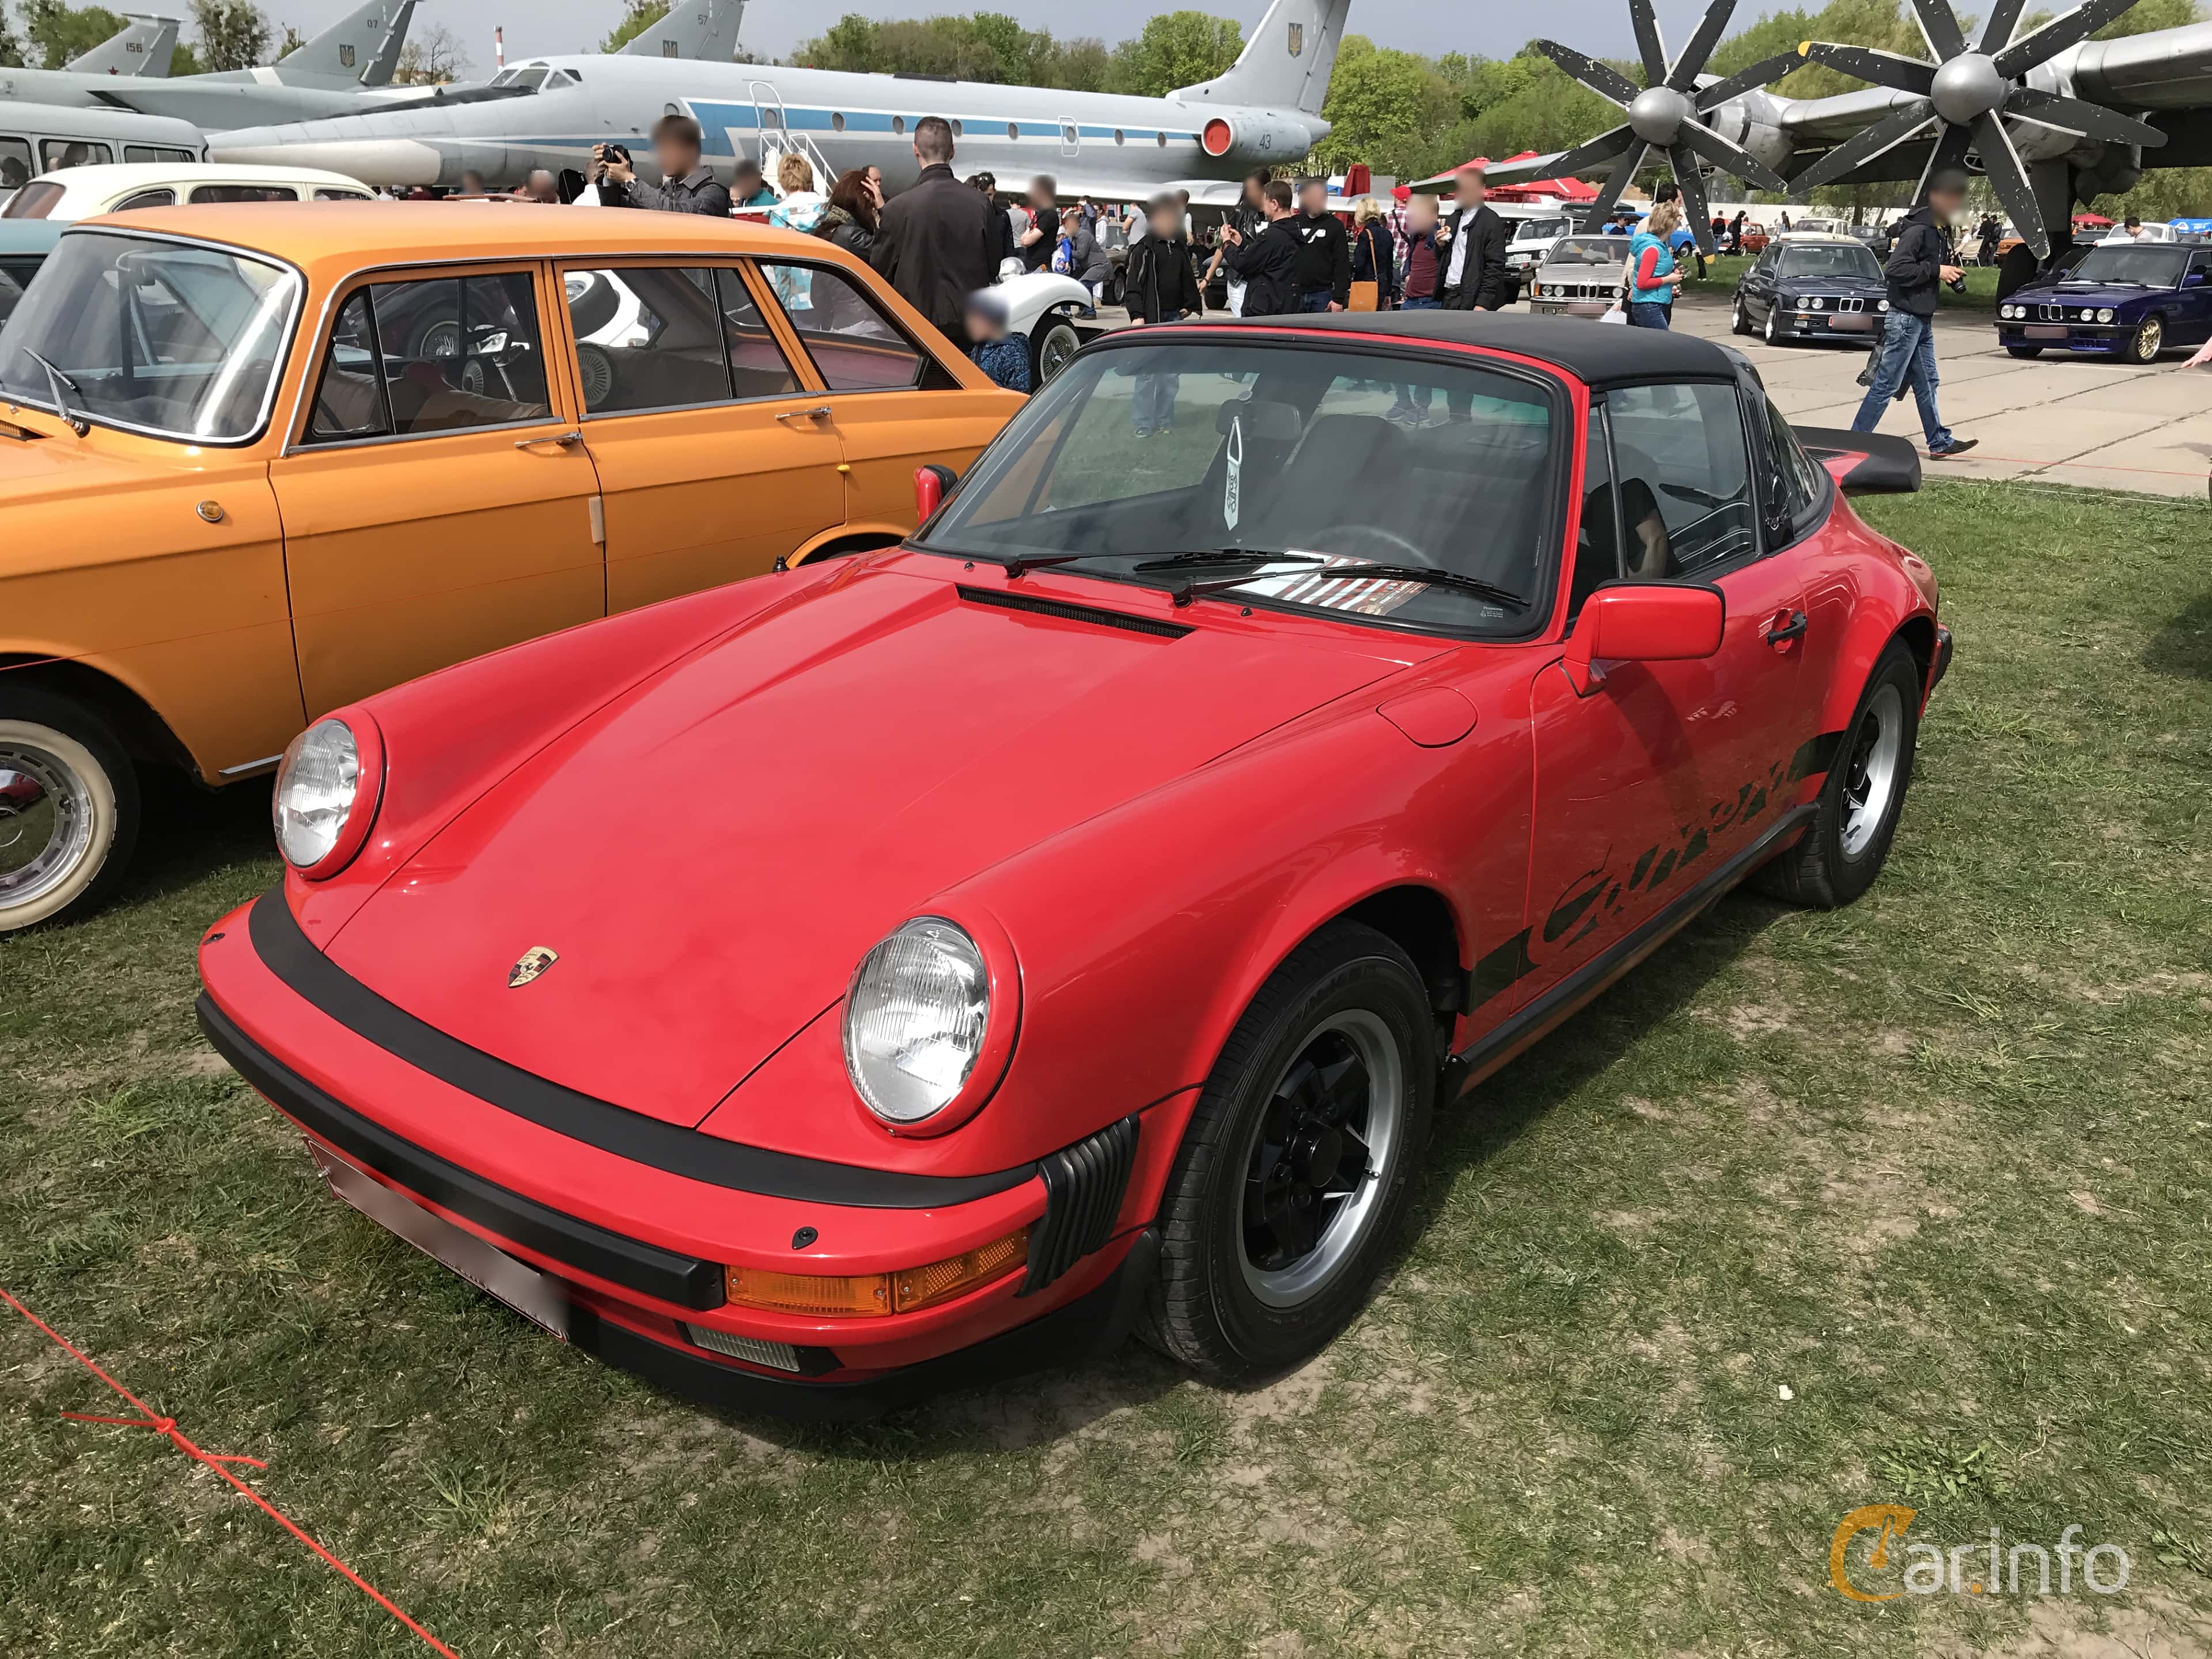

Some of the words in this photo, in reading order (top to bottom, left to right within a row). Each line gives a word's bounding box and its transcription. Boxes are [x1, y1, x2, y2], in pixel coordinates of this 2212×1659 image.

[367, 19, 378, 28] 07
[698, 14, 709, 25] 57
[126, 42, 143, 52] 156
[1259, 134, 1272, 150] 43
